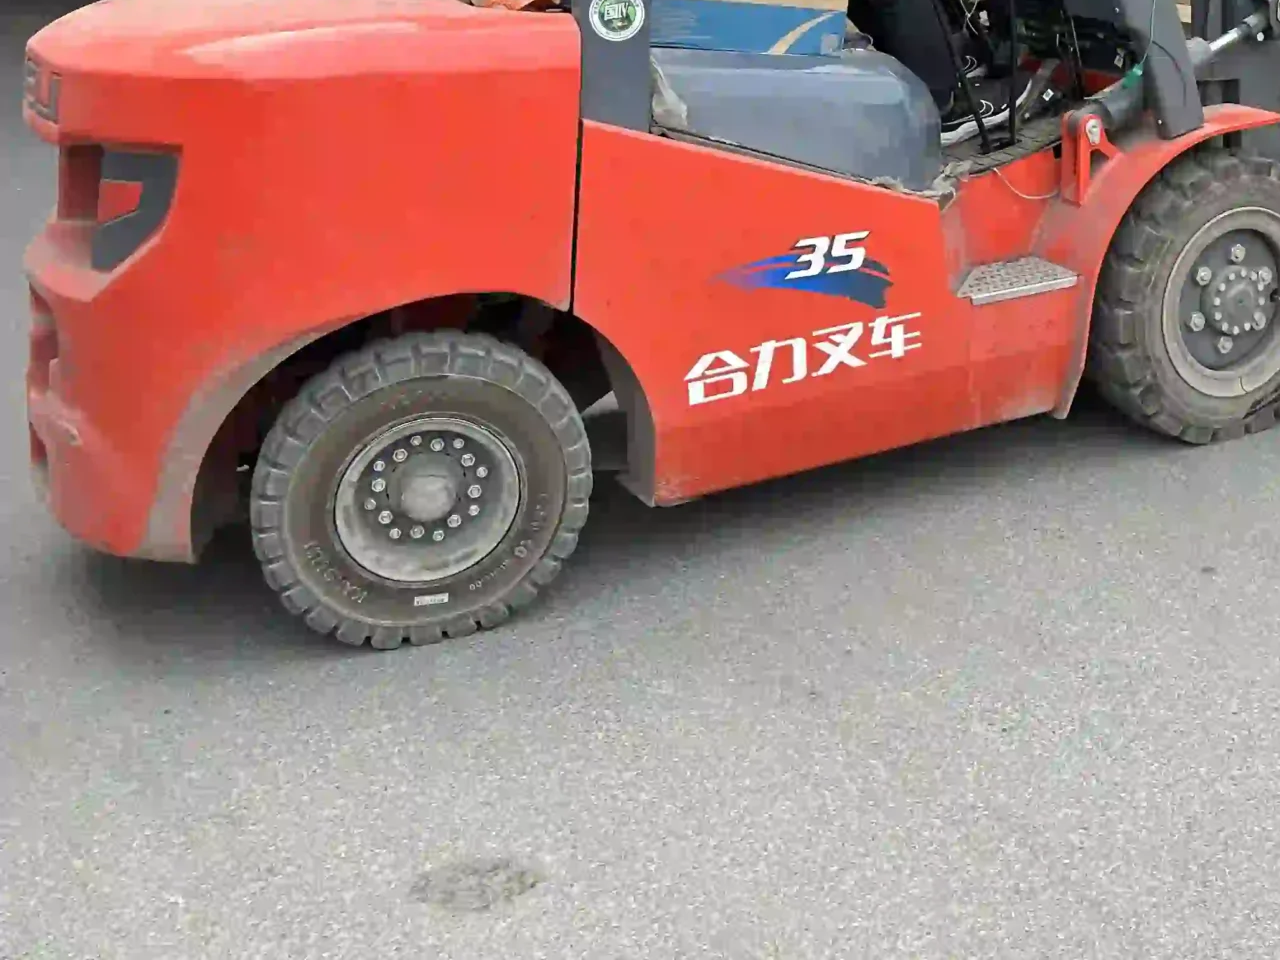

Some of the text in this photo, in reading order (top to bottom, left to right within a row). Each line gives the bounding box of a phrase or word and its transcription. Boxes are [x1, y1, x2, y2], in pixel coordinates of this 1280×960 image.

[784, 230, 871, 281] 35
[683, 311, 922, 406] 合力叉车
